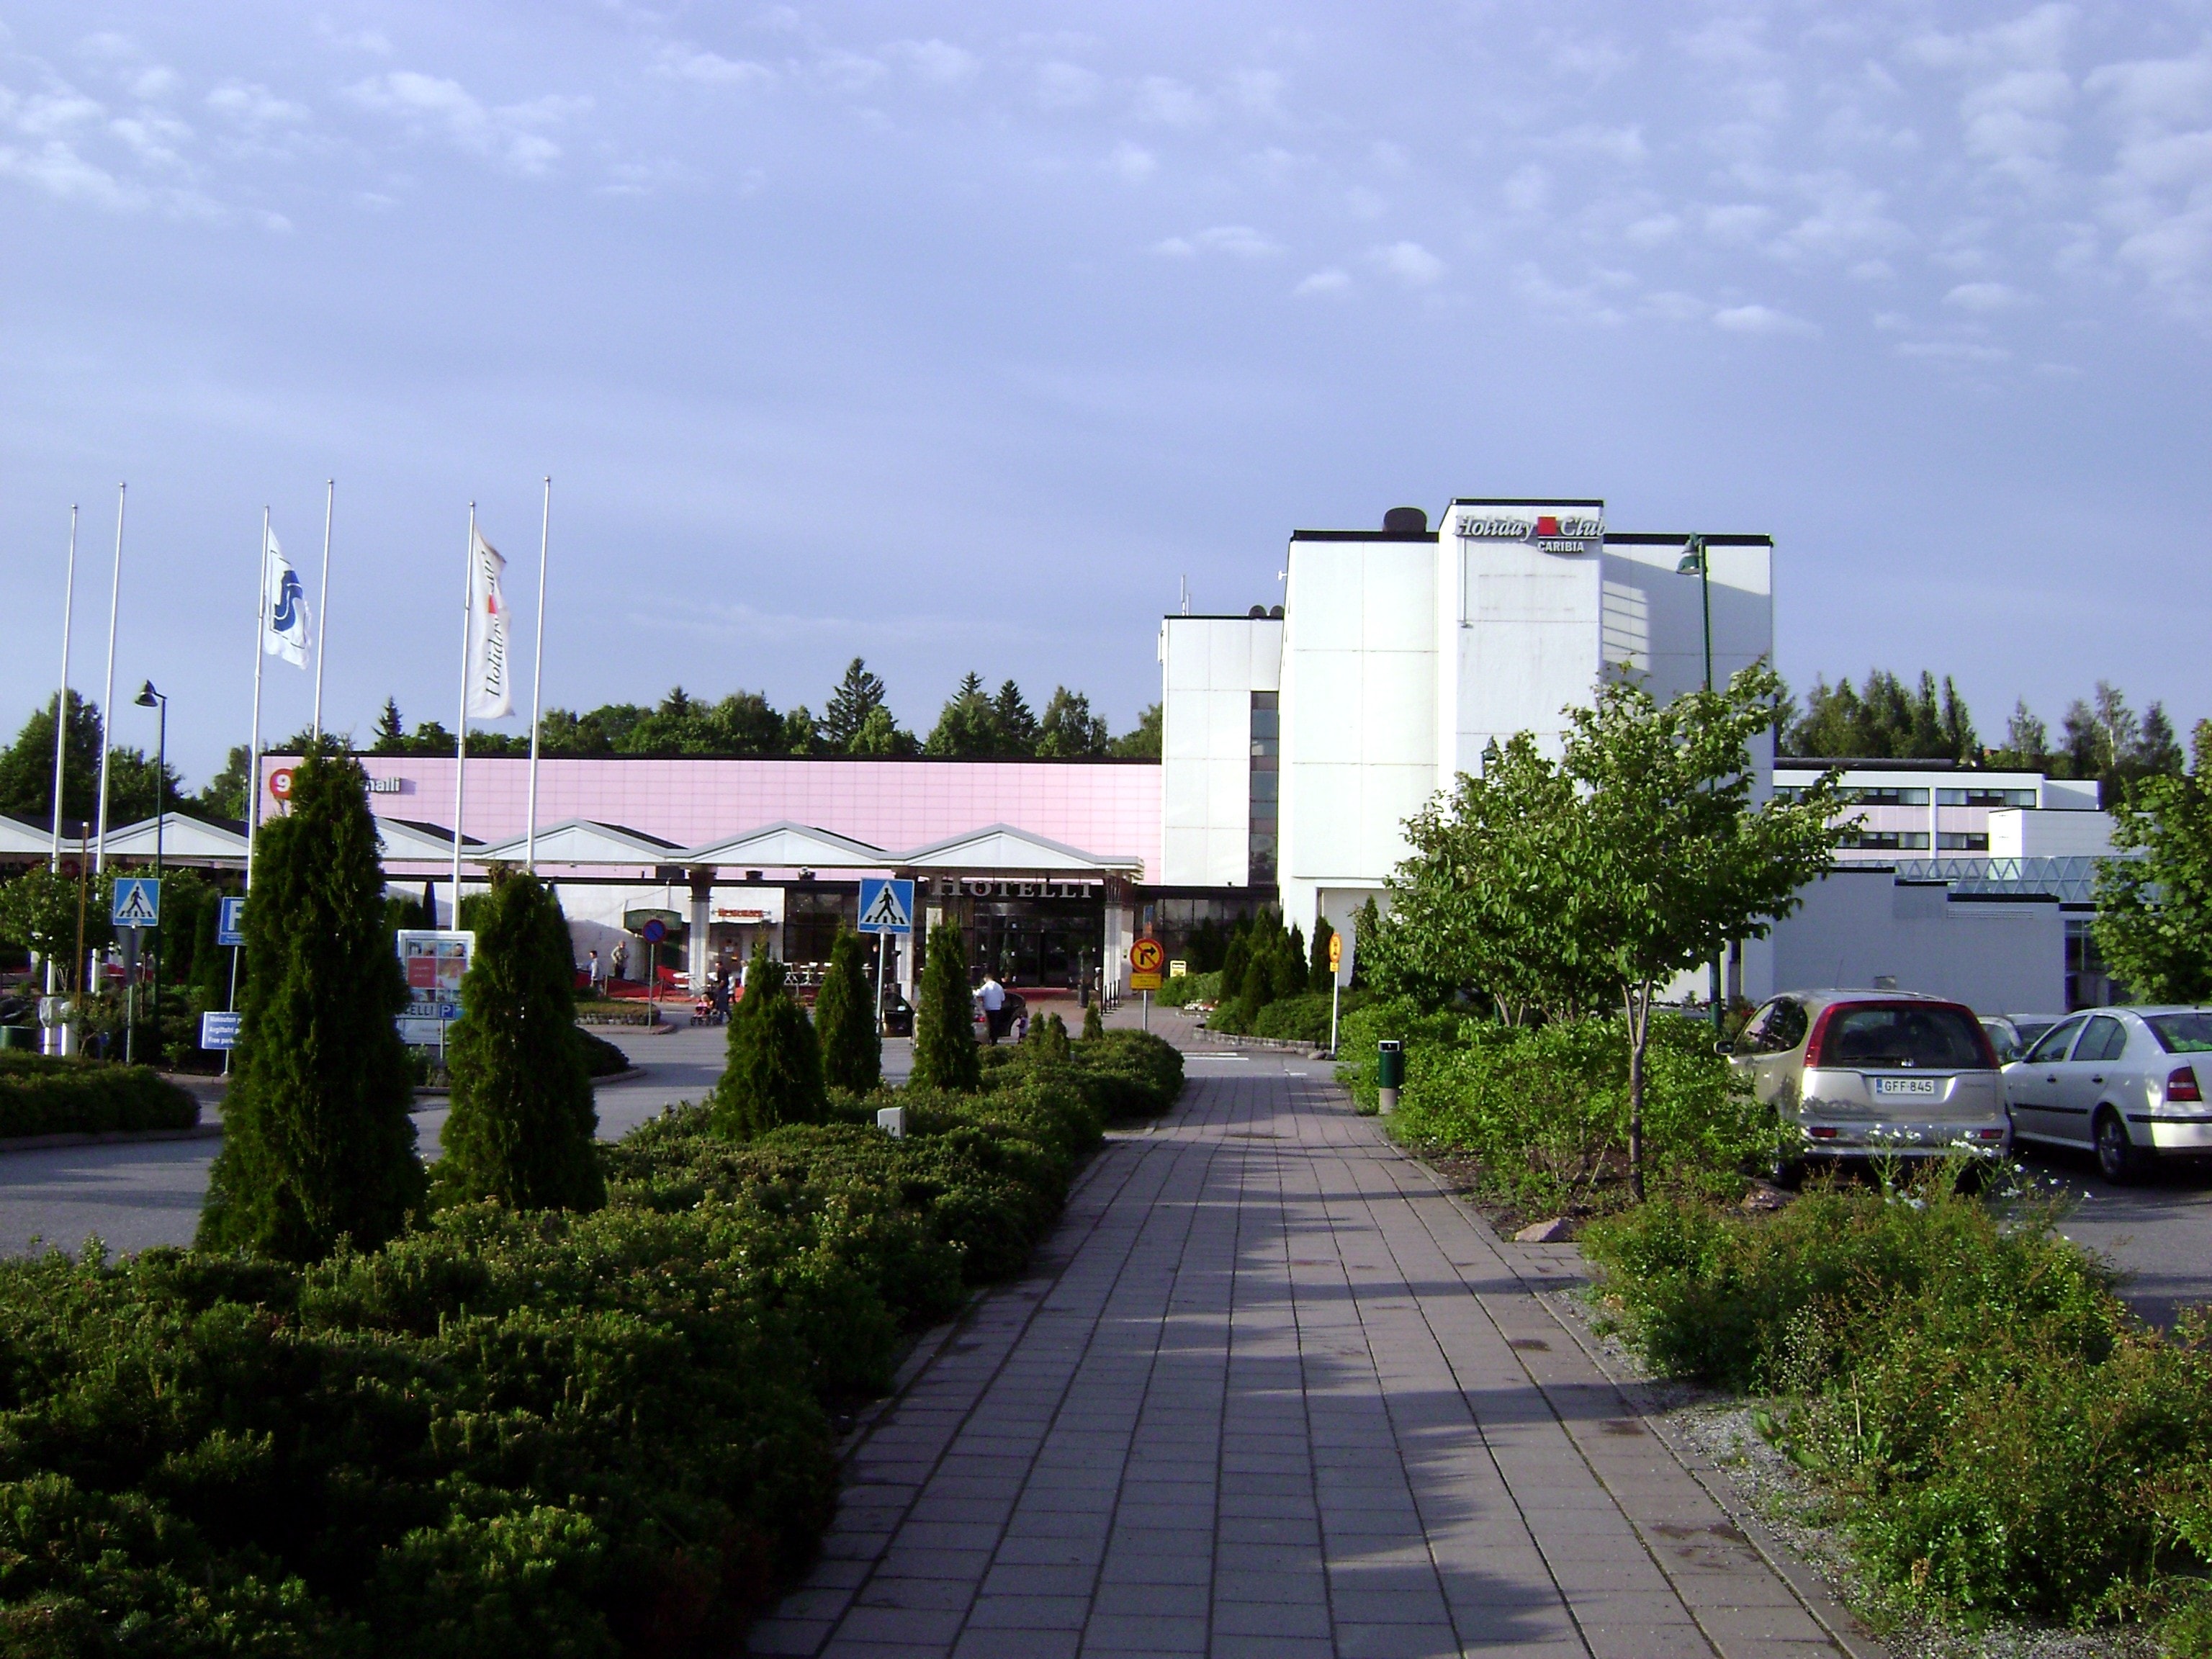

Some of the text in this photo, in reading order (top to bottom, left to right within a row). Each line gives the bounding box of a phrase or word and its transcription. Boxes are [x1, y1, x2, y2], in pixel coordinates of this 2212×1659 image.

[1453, 515, 1606, 542] Holiday Club
[1537, 541, 1584, 552] CARIBIA
[441, 1005, 451, 1017] P
[1884, 1081, 1933, 1092] GFF-845
